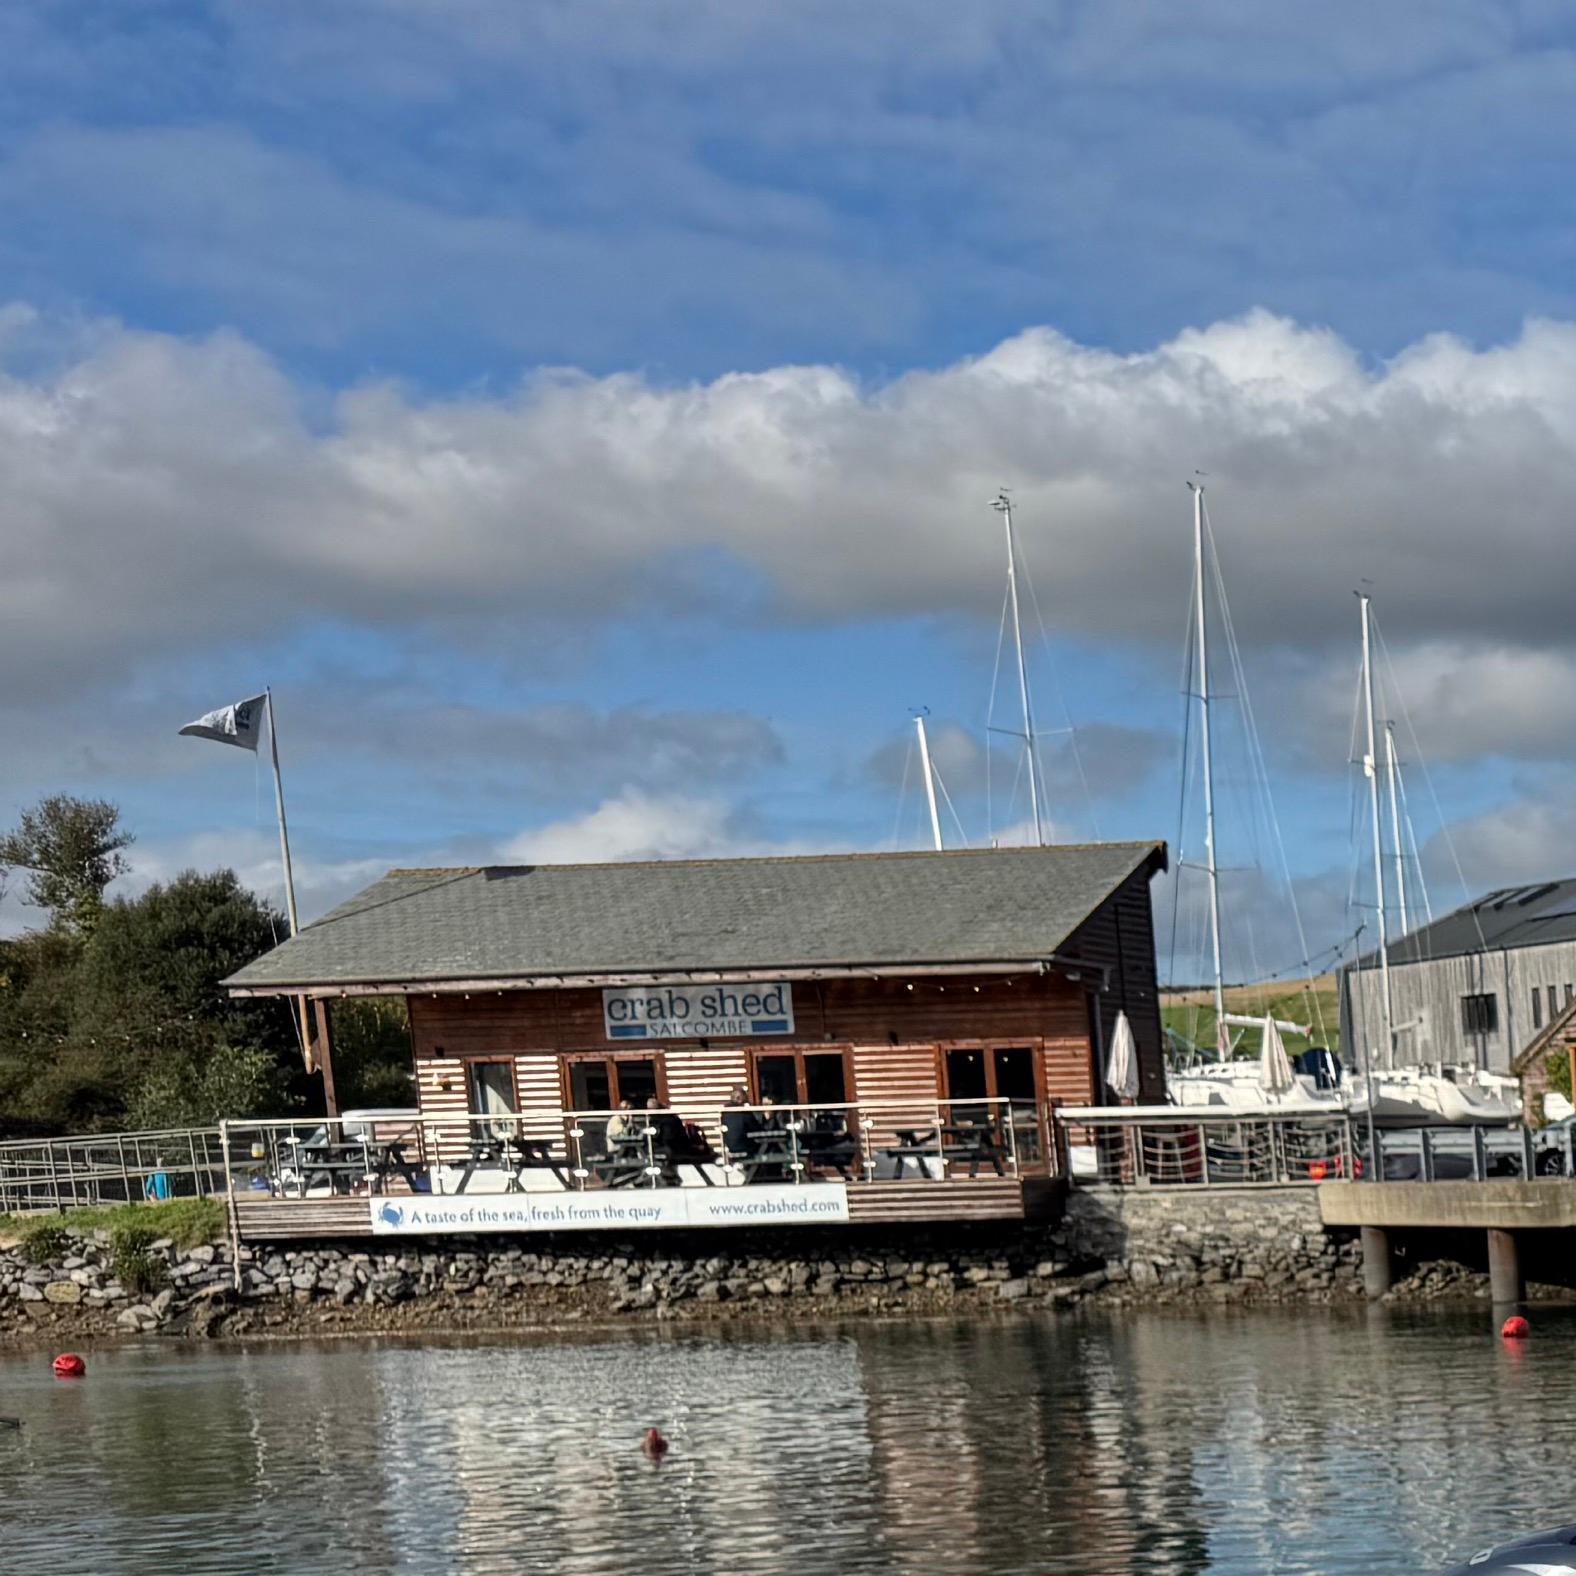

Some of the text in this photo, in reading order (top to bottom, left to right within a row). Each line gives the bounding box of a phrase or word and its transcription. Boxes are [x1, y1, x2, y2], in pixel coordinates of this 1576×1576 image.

[607, 985, 787, 1021] crab shed
[651, 1019, 746, 1036] SALCOMBE
[411, 1211, 422, 1223] A
[425, 1211, 457, 1223] taste
[460, 1207, 473, 1222] of
[478, 1207, 499, 1221] the
[531, 1205, 565, 1220] fresh
[568, 1204, 600, 1220] from
[604, 1203, 625, 1219] the
[629, 1206, 661, 1221] quay
[709, 1198, 840, 1215] www.crabshed.com
